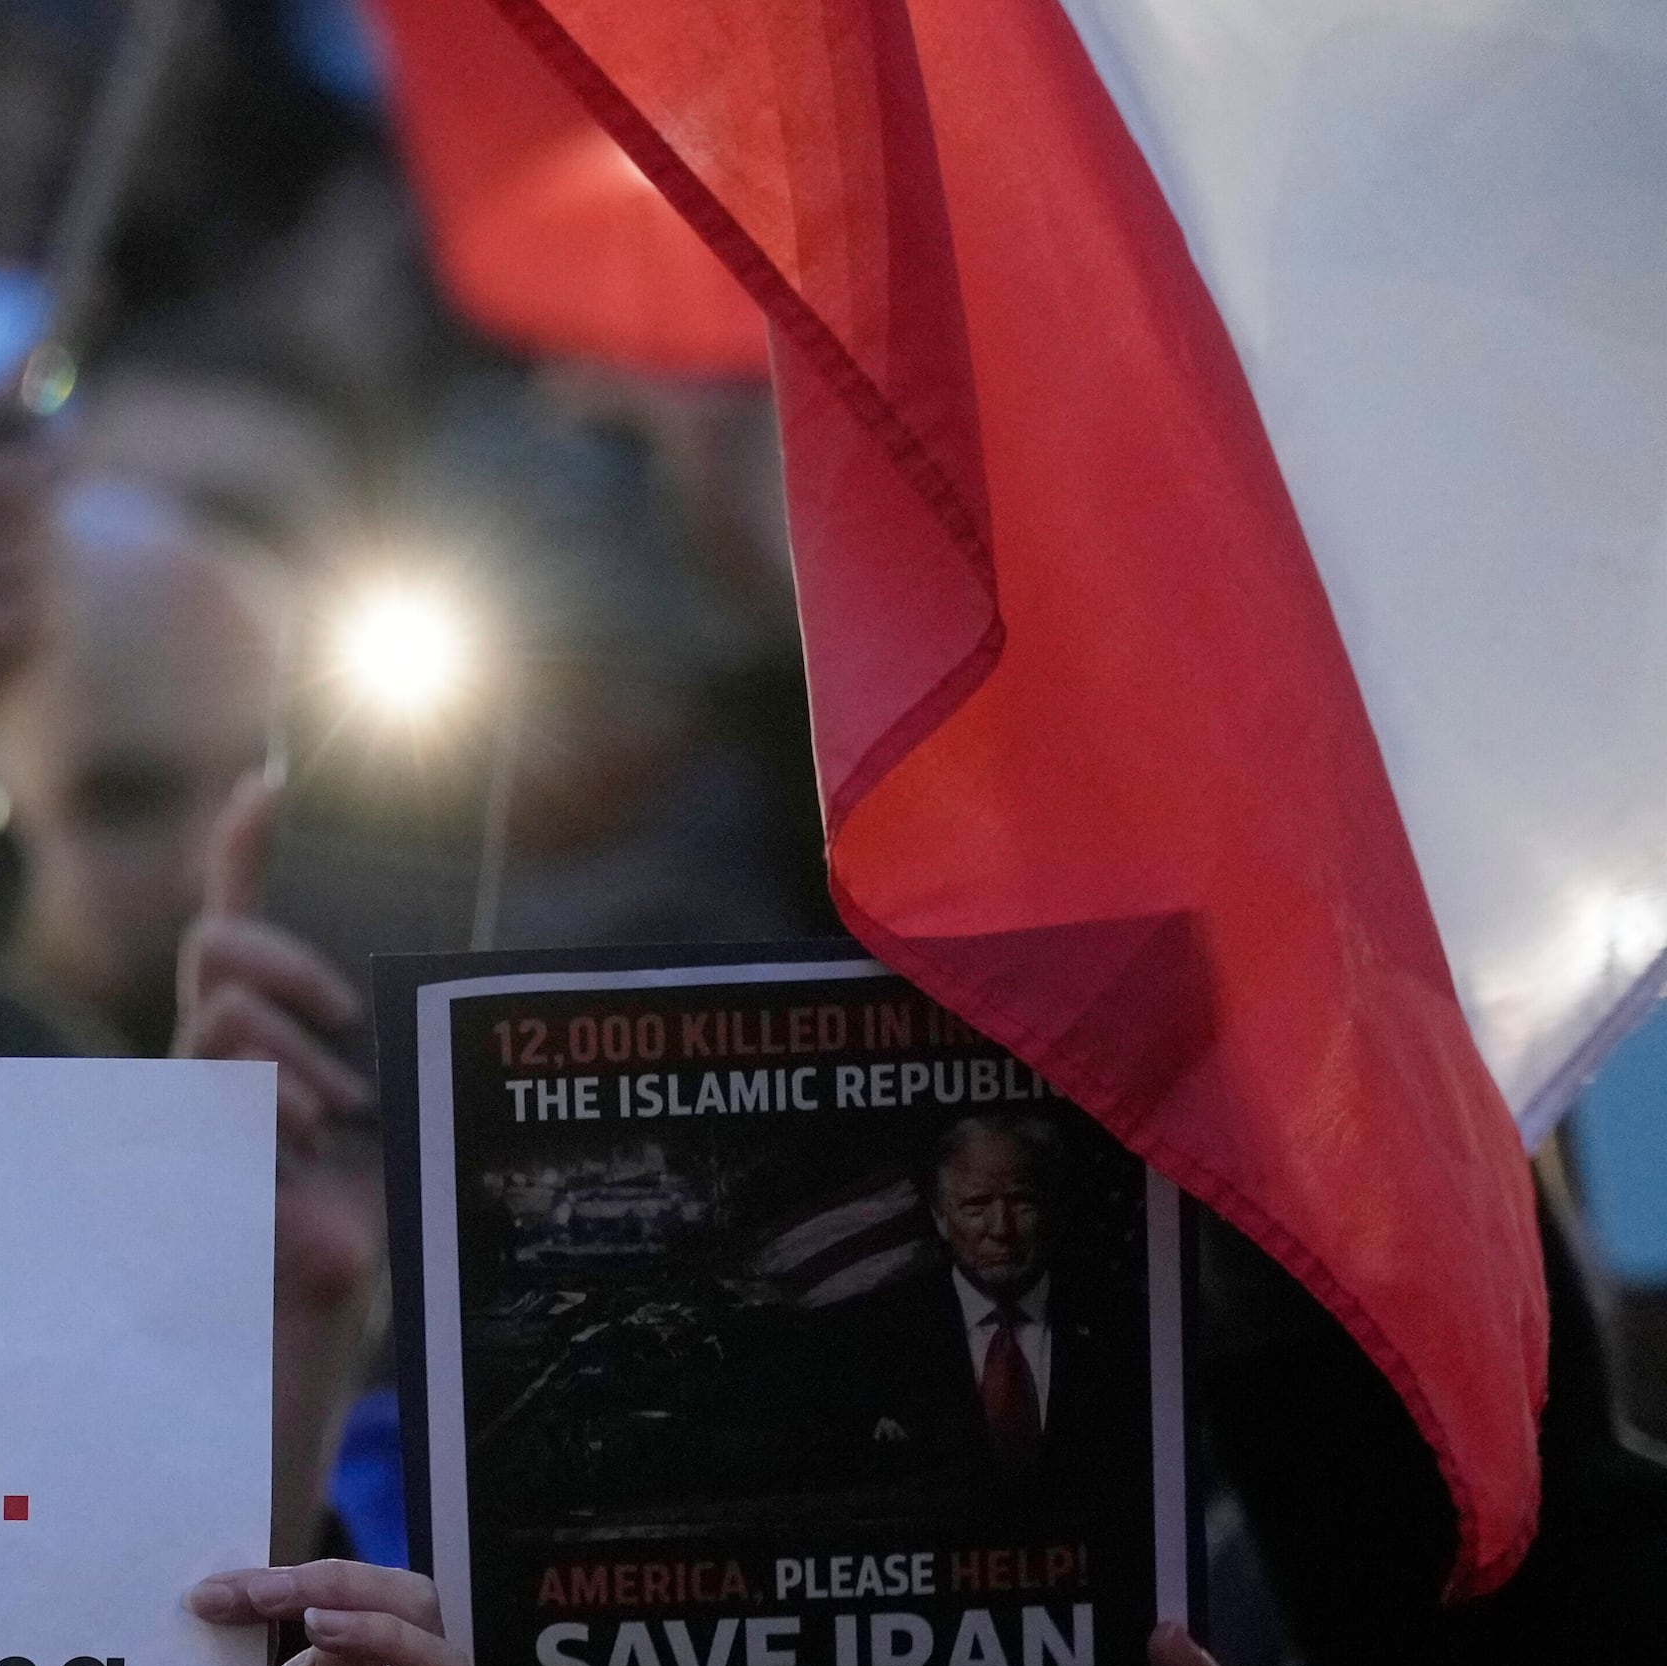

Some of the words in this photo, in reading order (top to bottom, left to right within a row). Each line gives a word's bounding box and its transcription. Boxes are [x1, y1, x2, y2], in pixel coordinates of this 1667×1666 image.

[492, 1015, 666, 1067] 12,000
[681, 1005, 845, 1060] KILLED
[862, 1002, 912, 1051] IN
[506, 1076, 600, 1122] THE
[617, 1067, 819, 1118] ISLAMIC
[538, 1561, 763, 1608] AMERICA,
[774, 1552, 936, 1599] PLEASE
[951, 1543, 1091, 1592] HELP!
